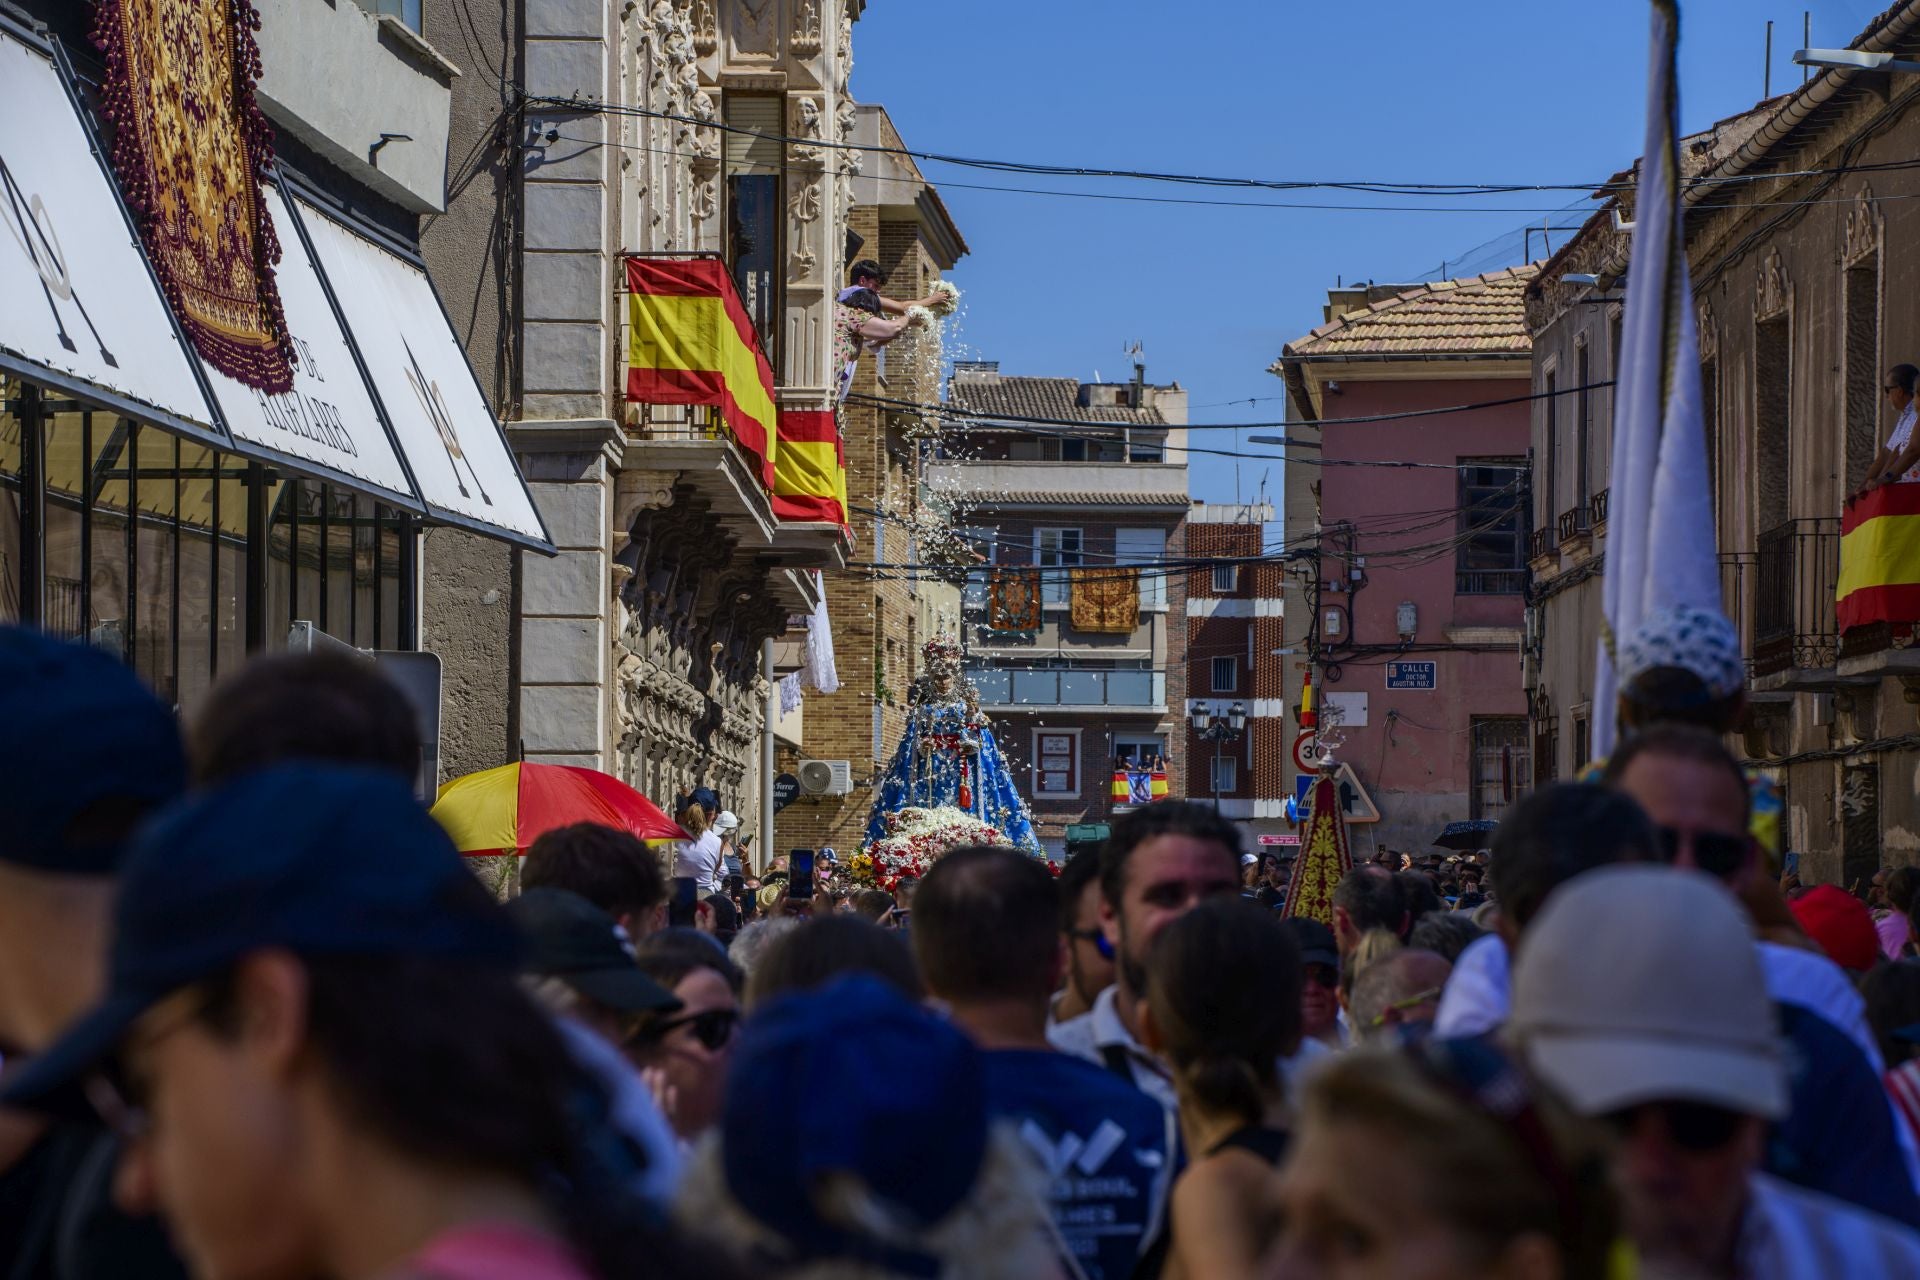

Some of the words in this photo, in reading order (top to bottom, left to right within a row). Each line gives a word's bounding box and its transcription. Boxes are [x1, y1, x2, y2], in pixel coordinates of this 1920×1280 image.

[292, 335, 325, 382] DE
[257, 389, 358, 458] ALGEZARES
[1402, 664, 1430, 673] CALLE
